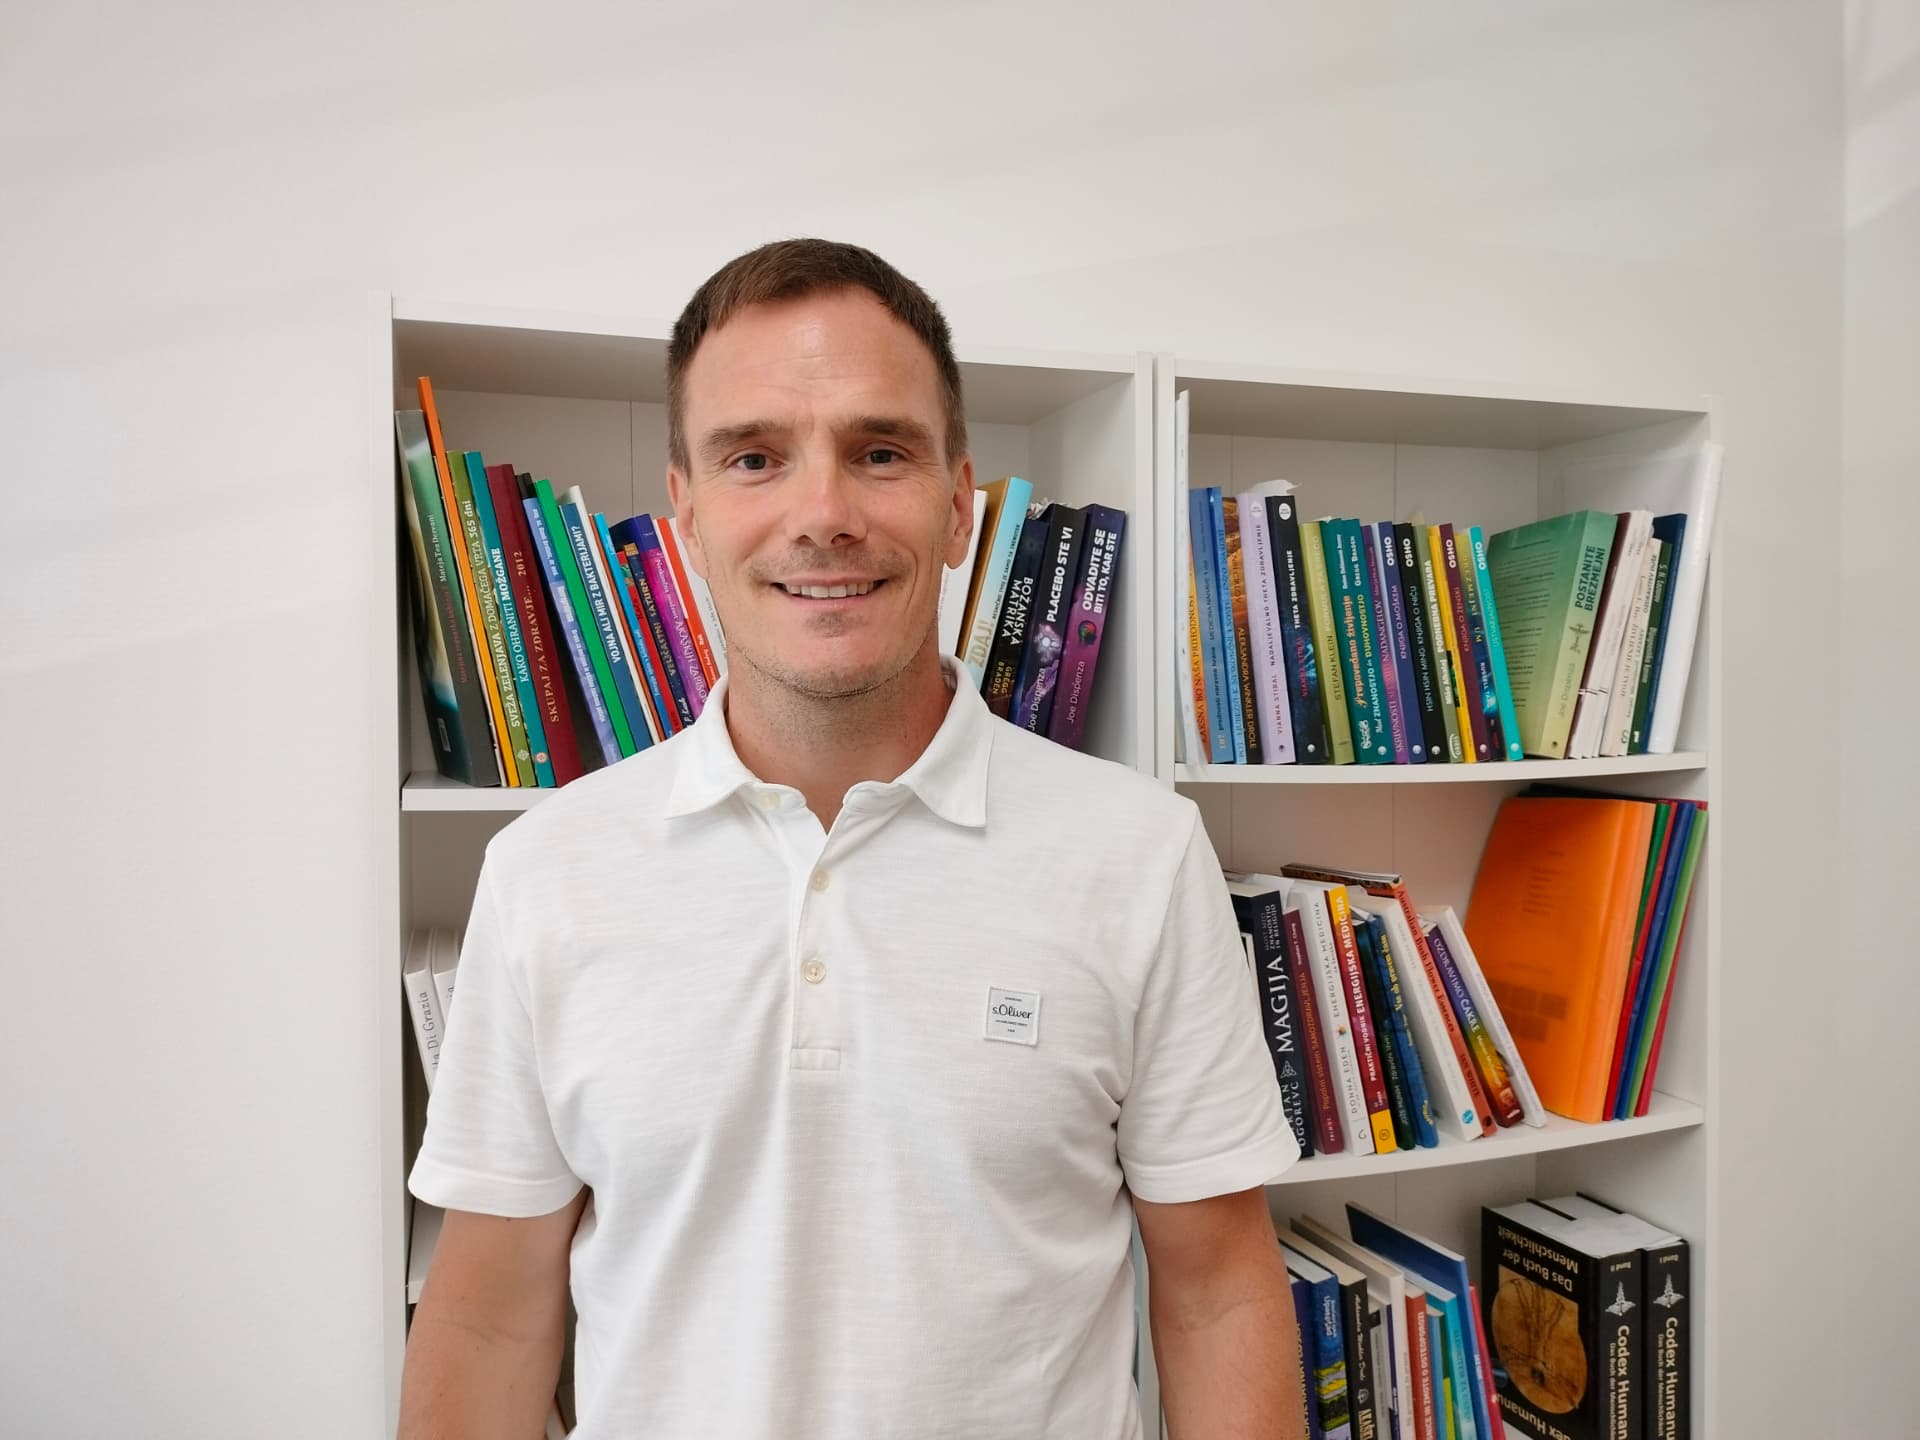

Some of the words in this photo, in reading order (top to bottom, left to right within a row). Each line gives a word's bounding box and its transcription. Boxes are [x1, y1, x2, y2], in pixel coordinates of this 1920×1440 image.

[462, 499, 472, 518] dni
[466, 519, 477, 537] 365
[1061, 526, 1072, 540] VI
[1105, 531, 1116, 551] STE
[471, 541, 483, 566] VRTA
[513, 550, 526, 576] 2012
[571, 524, 598, 590] BAKTERIJAMI?
[1057, 541, 1070, 564] STE
[1101, 552, 1112, 574] KAR
[1384, 535, 1394, 566] OSHO
[1402, 537, 1413, 567] OSHO
[1445, 538, 1456, 568] OSHO
[1475, 541, 1485, 570] OSHO
[490, 547, 510, 601] MOŽGANE
[1082, 547, 1102, 610] ODVADITE
[1094, 528, 1105, 545] SE
[1097, 575, 1109, 592] TO,
[1285, 549, 1298, 602] ZDRAVLJENJE
[1423, 559, 1436, 602] PREVARA
[1574, 545, 1595, 608] POSTANITE
[1584, 547, 1605, 611] BREZMEJNI
[476, 568, 496, 622] DOMAČEGA
[594, 598, 606, 616] MIR
[639, 577, 656, 617] SATURN
[1000, 579, 1023, 638] MATRIKA
[1008, 576, 1036, 646] BOŽANSKA
[1046, 565, 1066, 622] PLACEBO
[1094, 593, 1104, 613] BITI
[1390, 584, 1401, 621] MOŠKEM
[503, 601, 522, 653] OHRANITI
[599, 616, 611, 632] ALI
[1292, 604, 1300, 628] THETA
[1357, 594, 1372, 657] DUHOVNOSTJO
[1414, 616, 1424, 644] KNJIGA
[1430, 603, 1444, 652] PODNEBNA
[492, 632, 512, 691] ZELENJAVA
[605, 632, 621, 662] VOJNA
[652, 621, 675, 676] VELIČASTNI
[1238, 627, 1249, 681] ALEKSANDRA
[1326, 634, 1336, 662] KLEIN
[1397, 631, 1406, 659] KNJIGA
[515, 653, 528, 682] KAKO
[537, 654, 548, 672] ZA
[992, 661, 1004, 694] BRADEN
[1192, 660, 1200, 684] NAŠA
[541, 675, 559, 722] SKUPAJ
[1030, 667, 1046, 711] Dispenza
[1070, 660, 1085, 704] Dispenza
[1330, 664, 1341, 700] STEFAN
[1367, 667, 1380, 717] ZNANOSTJO
[1422, 671, 1430, 691] HSIN
[504, 693, 520, 728] SVEŽA
[1066, 705, 1076, 722] Joe
[1243, 683, 1253, 718] WINKLER
[1424, 692, 1433, 711] HSIN
[1027, 713, 1036, 731] Joe
[1313, 901, 1327, 952] MEDICINA
[1335, 895, 1352, 948] MEDICINA
[1275, 939, 1280, 948] IN
[1396, 889, 1420, 936] Australian
[1414, 936, 1429, 960] Bush
[1424, 961, 1442, 993] Flower
[1436, 993, 1457, 1032] Essences
[1324, 956, 1340, 1017] ENERGIJSKA
[1344, 949, 1366, 1013] ENERGIJSKA
[1432, 937, 1464, 998] OZDRAVIMO
[1459, 996, 1482, 1033] ČAKRE
[416, 991, 434, 1032] Grazia
[1265, 953, 1295, 1053] MAGIJA
[425, 1034, 439, 1050] Di
[1339, 1045, 1350, 1073] EDEN
[1363, 1042, 1377, 1081] PRAKTIČNI
[1345, 1077, 1357, 1114] DONNA
[1497, 1224, 1579, 1274] Menschlichkeit
[1501, 1247, 1521, 1268] der
[1522, 1258, 1550, 1281] Buch
[1551, 1271, 1574, 1292] Das
[1616, 1324, 1630, 1376] Codex
[1664, 1316, 1678, 1367] Codex
